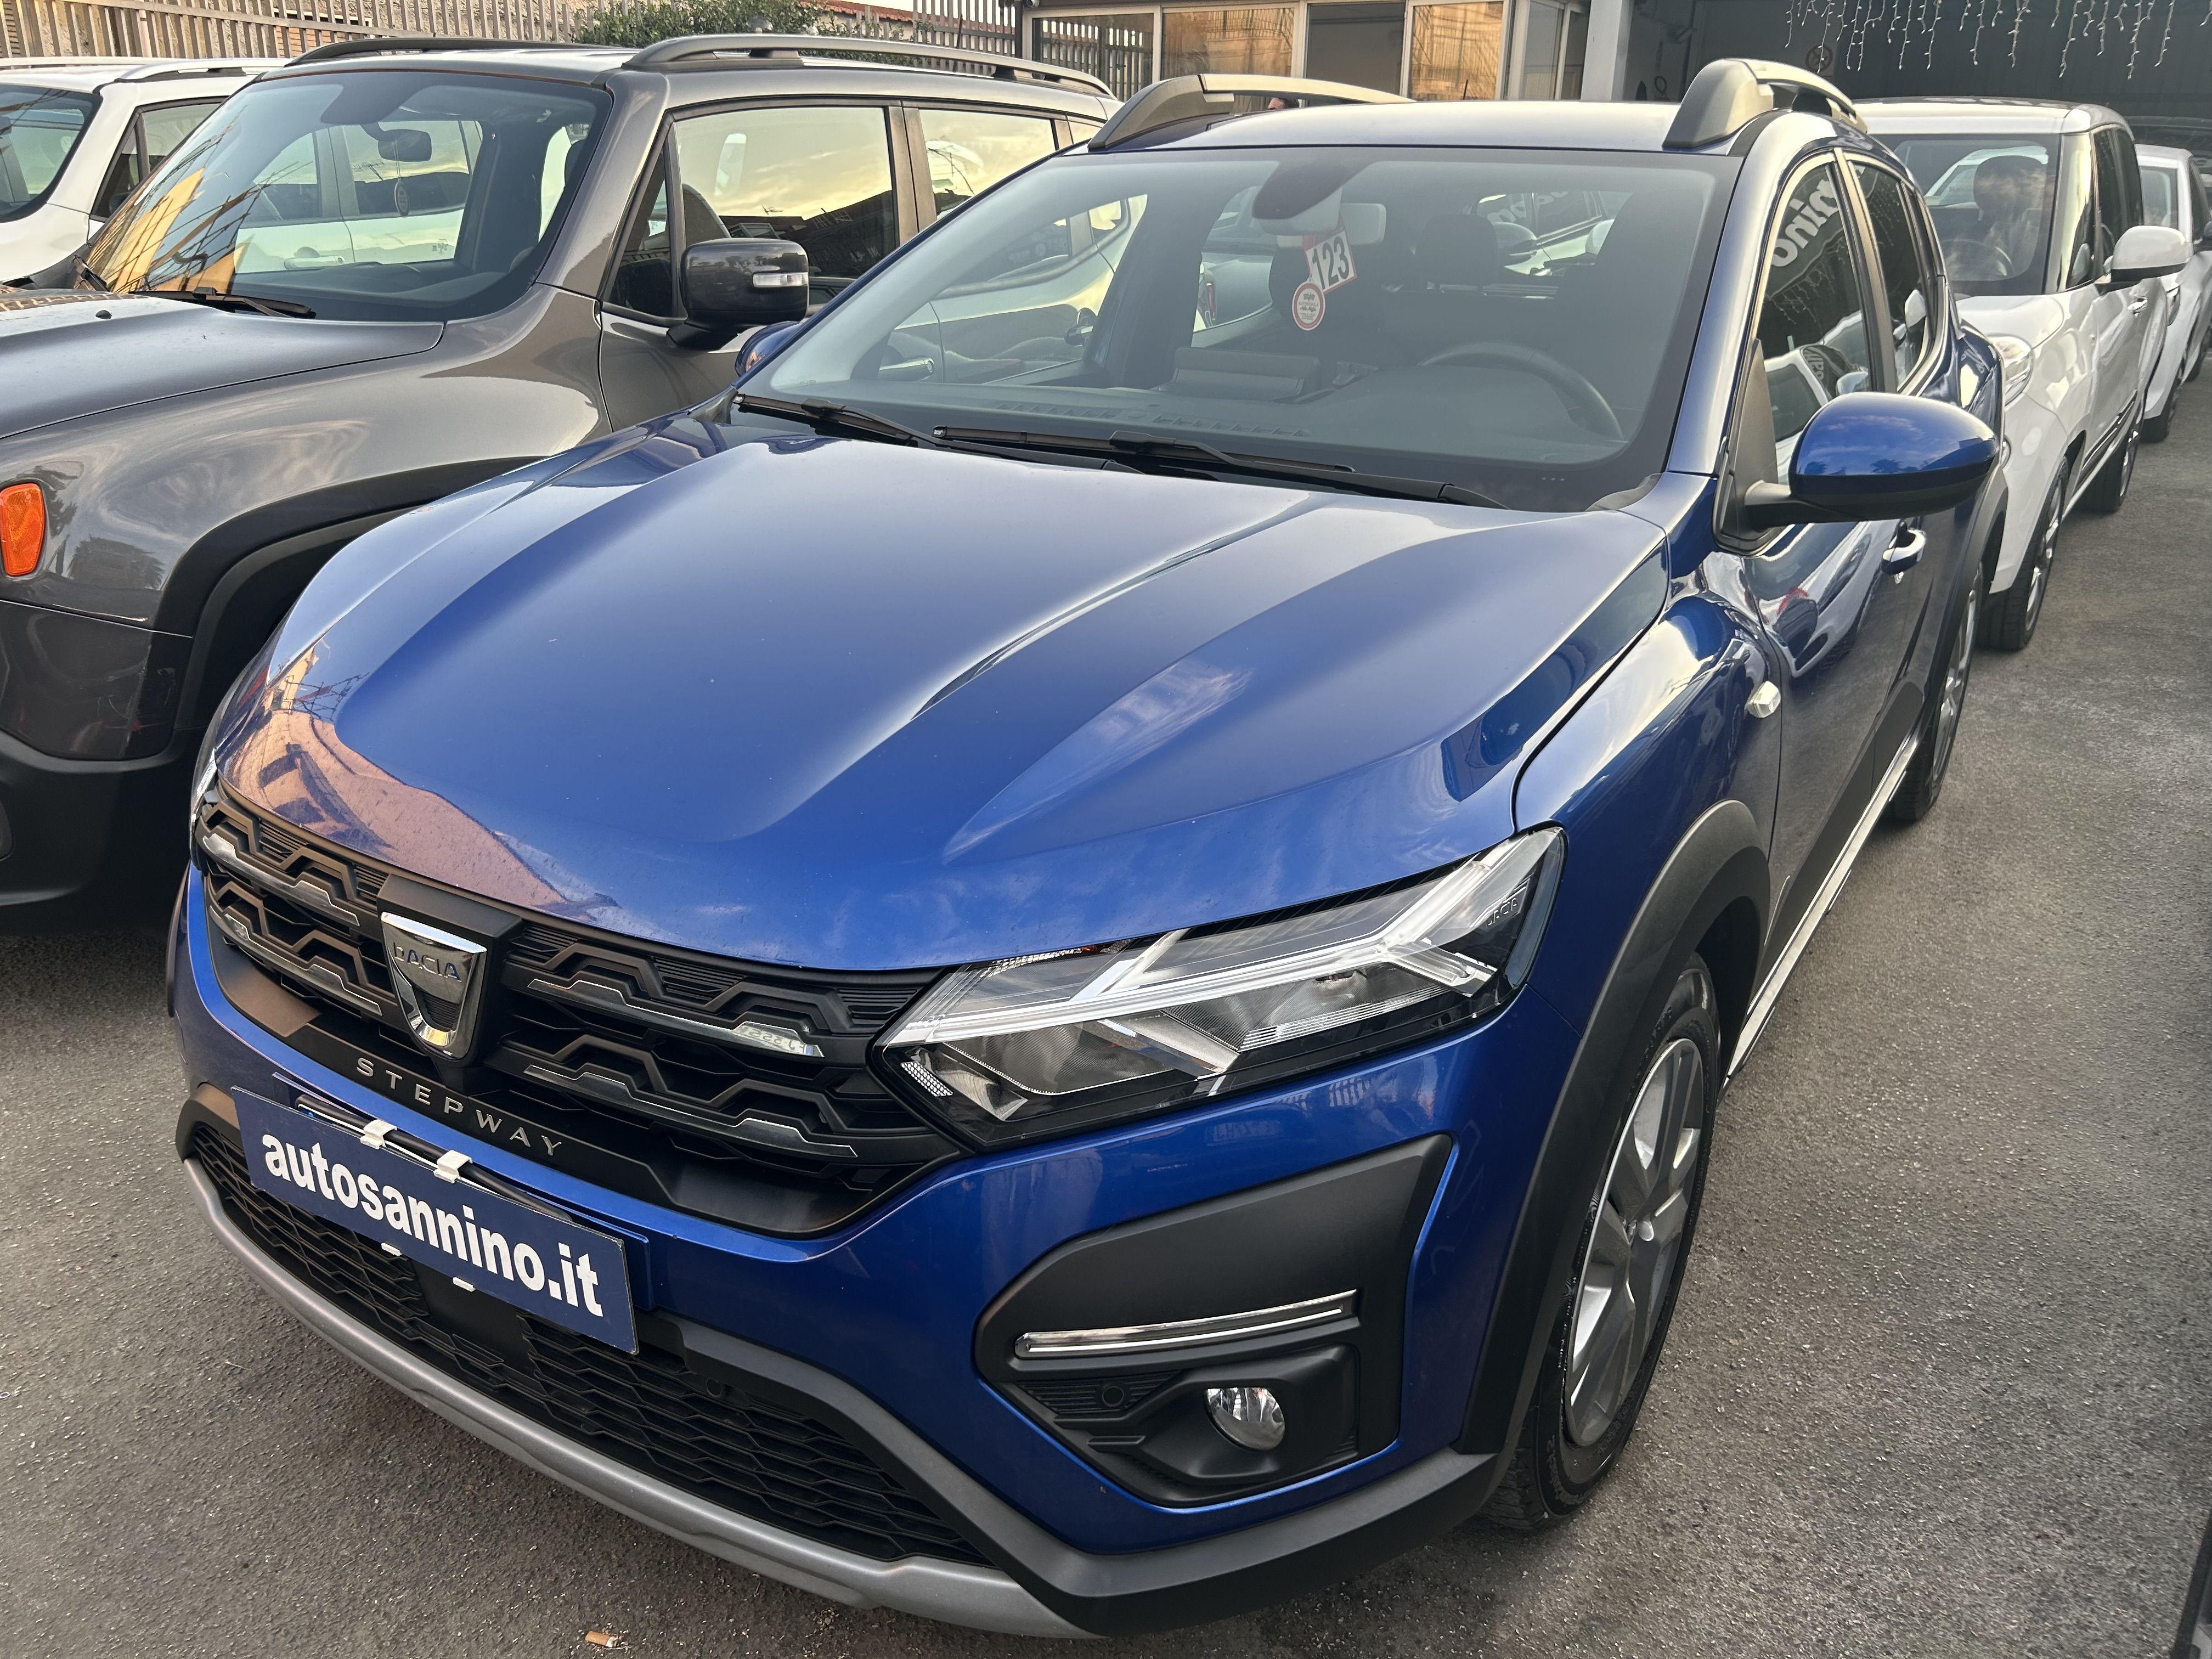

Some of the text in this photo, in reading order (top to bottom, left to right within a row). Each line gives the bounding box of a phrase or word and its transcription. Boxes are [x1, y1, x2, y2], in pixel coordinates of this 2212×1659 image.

[1312, 236, 1350, 290] 123
[393, 941, 462, 983] DACIA
[357, 1057, 563, 1156] STEPWAY
[262, 1134, 604, 1318] autosannino.it
